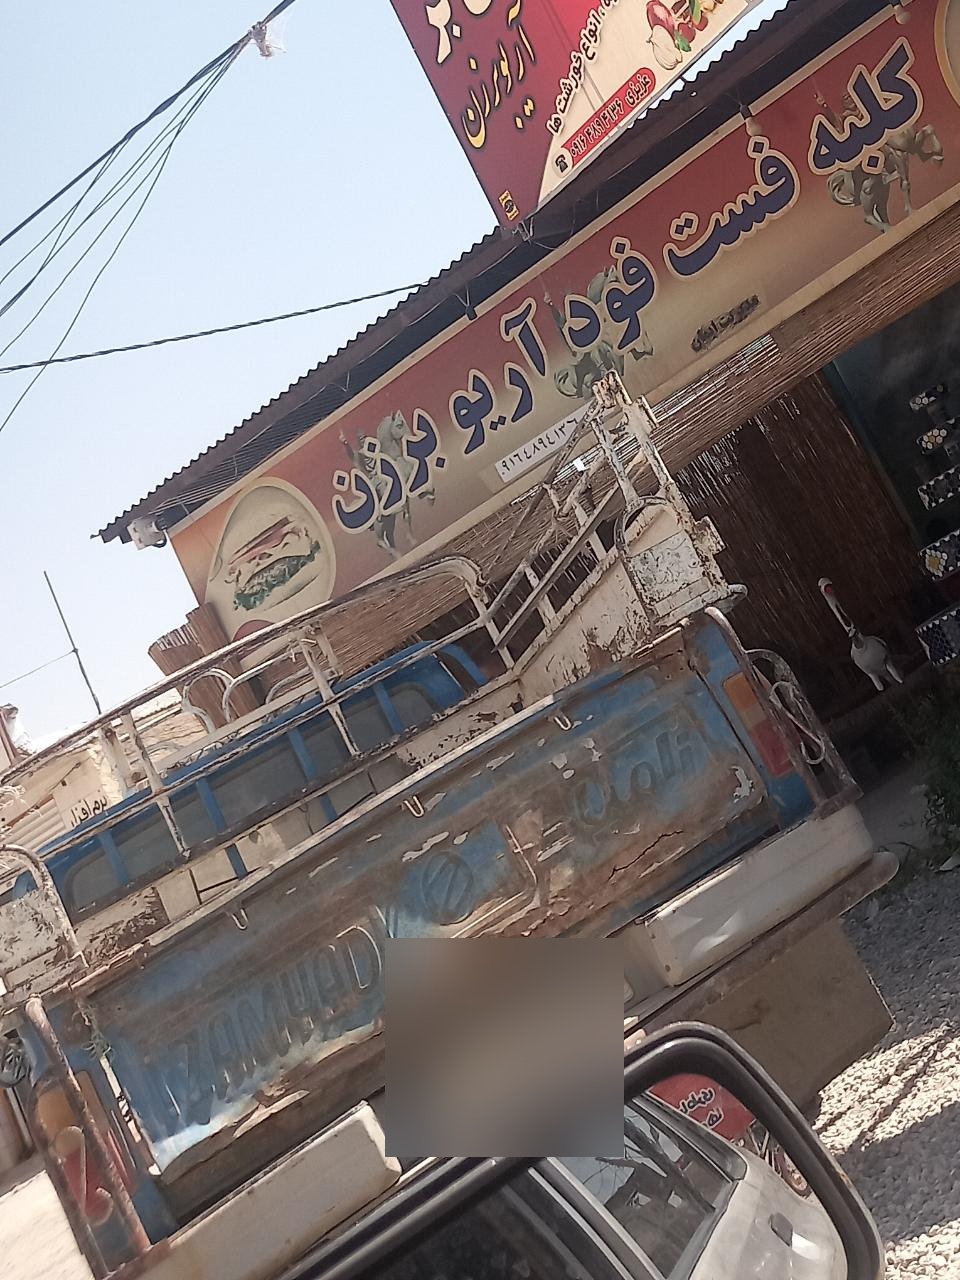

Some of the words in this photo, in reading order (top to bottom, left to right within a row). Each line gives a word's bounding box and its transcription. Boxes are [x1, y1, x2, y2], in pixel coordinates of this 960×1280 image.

[556, 50, 585, 114] خورشت
[579, 9, 603, 61] انواع
[625, 74, 651, 107] عزیزی
[547, 113, 563, 136] ها
[808, 38, 922, 174] کلبه
[664, 136, 800, 277] فست
[565, 238, 657, 352] فود
[450, 298, 546, 456] آریو
[332, 408, 446, 534] برزن
